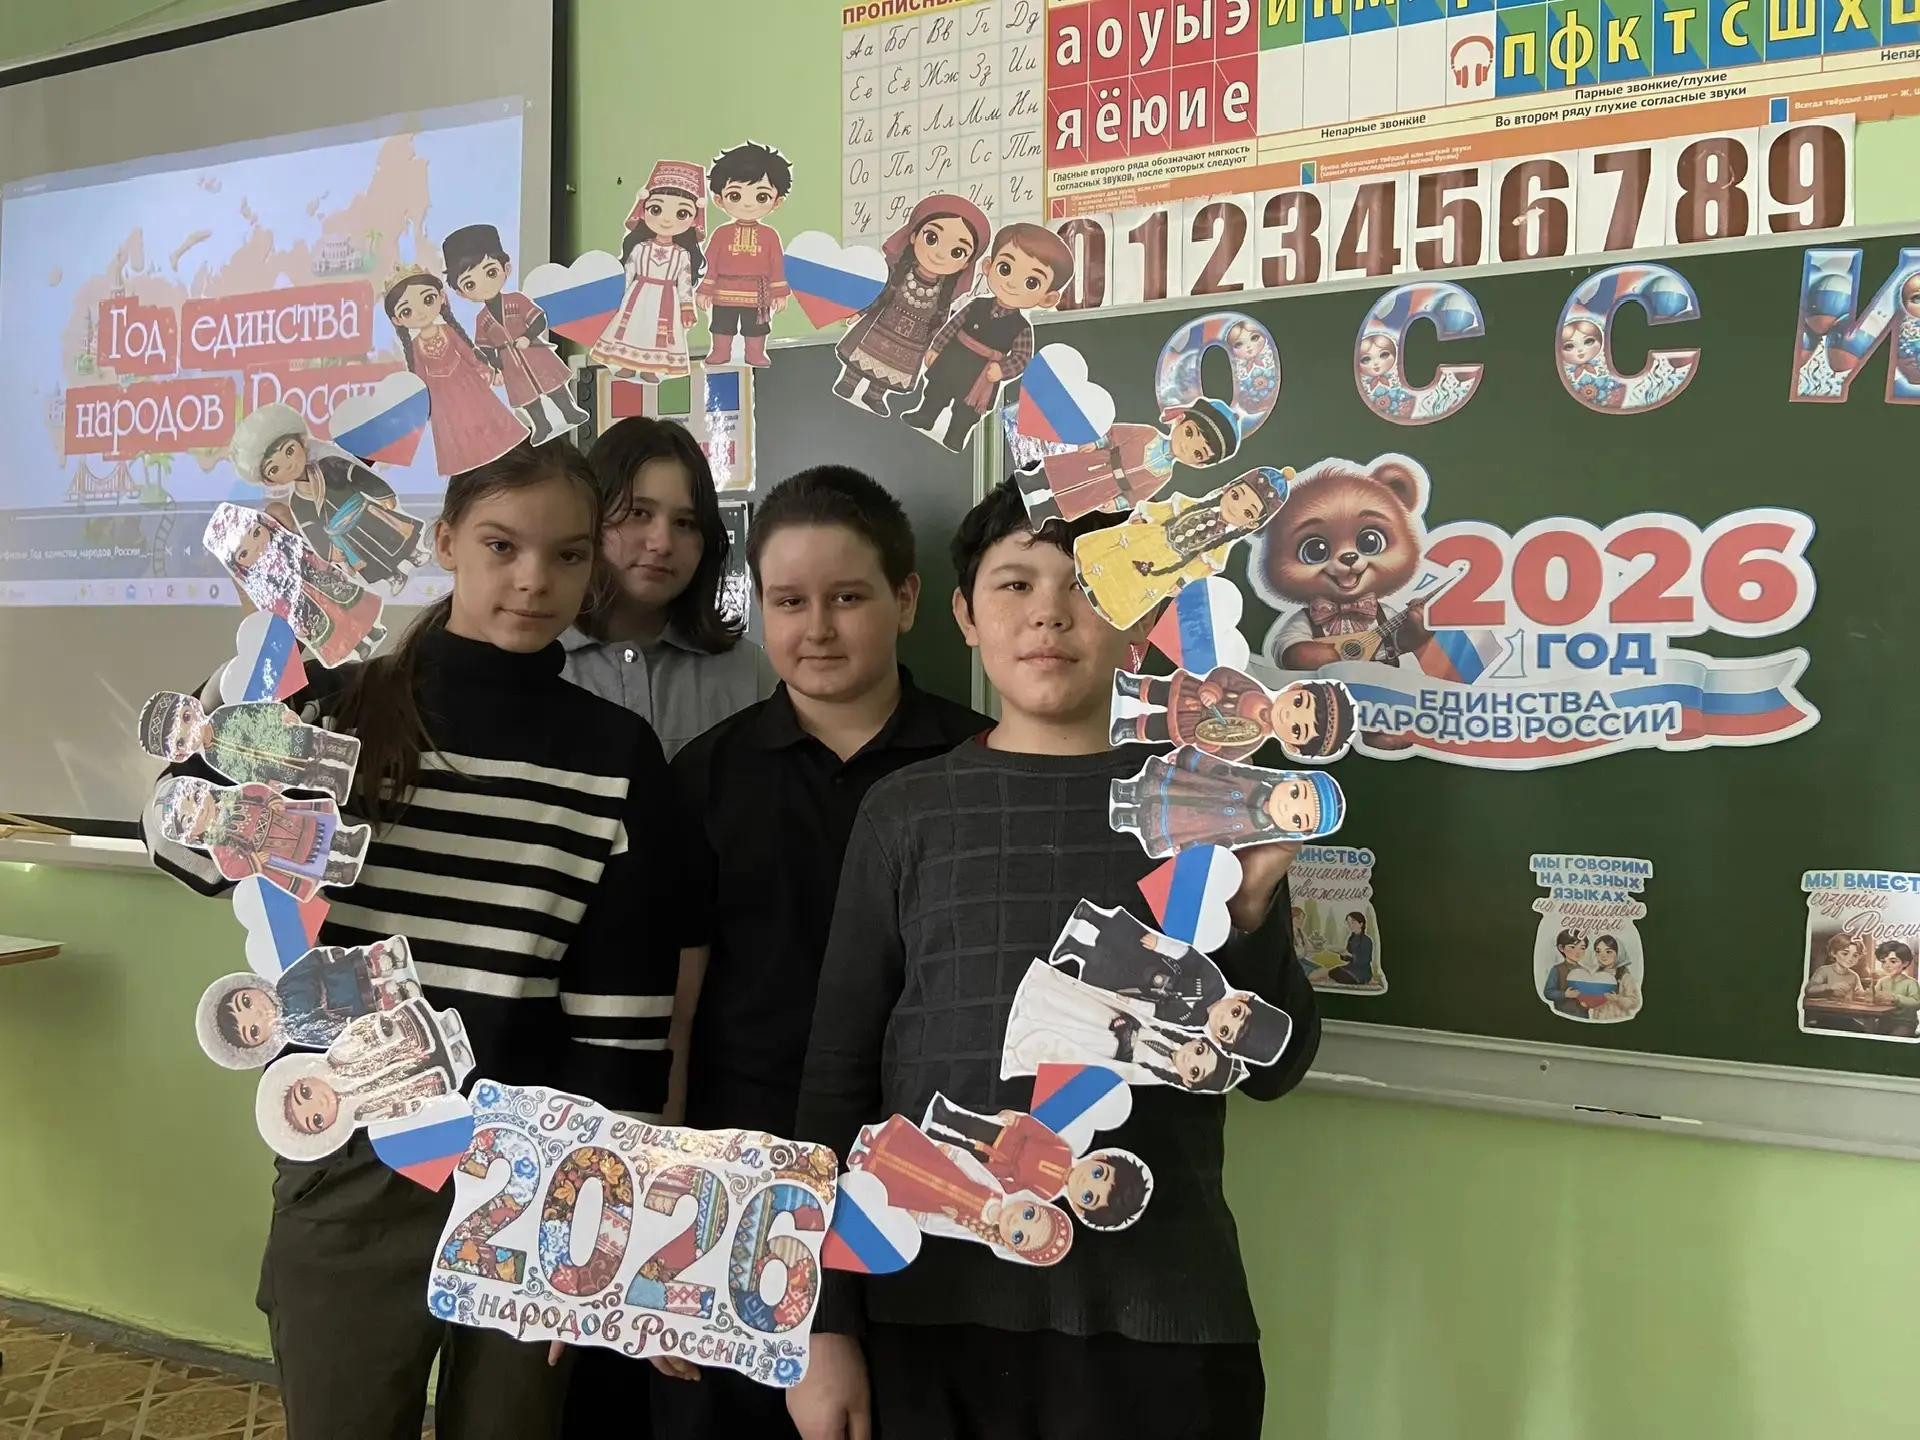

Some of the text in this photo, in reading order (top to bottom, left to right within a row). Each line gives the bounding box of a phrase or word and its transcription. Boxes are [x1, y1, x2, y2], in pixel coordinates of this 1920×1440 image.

[846, 0, 1040, 60] Аа Бб Вв Гг Дд
[1056, 26, 1082, 66] а
[1096, 18, 1123, 58] о
[1138, 8, 1164, 68] у
[1176, 0, 1212, 44] ы
[1225, 0, 1250, 36] э
[1503, 32, 1536, 78] п
[1550, 9, 1594, 86] ф
[1607, 15, 1642, 64] к
[1663, 8, 1696, 55] т
[1720, 0, 1750, 47] с
[1769, 0, 1816, 42] ш
[1832, 0, 1870, 32] х
[850, 45, 1036, 100] Ее Ёё Жж Зз Ии
[1575, 72, 1728, 100] Парные звонкие/глухие
[849, 90, 1038, 145] Йй Кк Лл Мм Нн
[1056, 81, 1250, 150] я ё ю и е
[1495, 86, 1746, 128] Во втором ряду глухие согласные звуки
[1795, 100, 1823, 109] Всегда
[1320, 114, 1426, 138] Непарные звонкие
[850, 131, 1042, 185] Оо Пп Рр Сс Тт
[1053, 145, 1250, 182] Гласные второго ряда обозначают мягкость
[1056, 156, 1246, 192] согласных звуков, после которых следуют
[851, 202, 871, 232] Уу
[1010, 176, 1034, 202] Чч
[1056, 126, 1846, 310] 0 1 2 3 4 5 6 7 8 9
[108, 298, 360, 365] Год единства
[75, 371, 376, 457] народов Росс
[1425, 523, 1798, 626] 2026
[1538, 633, 1656, 676] ГОД
[1420, 689, 1610, 716] ЕДИНСТВА
[1526, 706, 1677, 740] РОССИИ
[1288, 865, 1368, 880] ачинается
[1297, 848, 1371, 865] ИНСТВО
[1533, 857, 1649, 874] МЫ ГОВОРИМ
[1540, 872, 1640, 888] НА РАЗНЫХ
[1804, 874, 1920, 891] МЫ ВМЕСТ
[1559, 902, 1641, 916] понимаем
[1811, 891, 1888, 917] создаём
[1561, 916, 1622, 938] сердцем
[1843, 911, 1920, 941] Росси
[540, 1094, 602, 1143] Год
[437, 1127, 825, 1334] 2026
[478, 1293, 759, 1367] народов России
